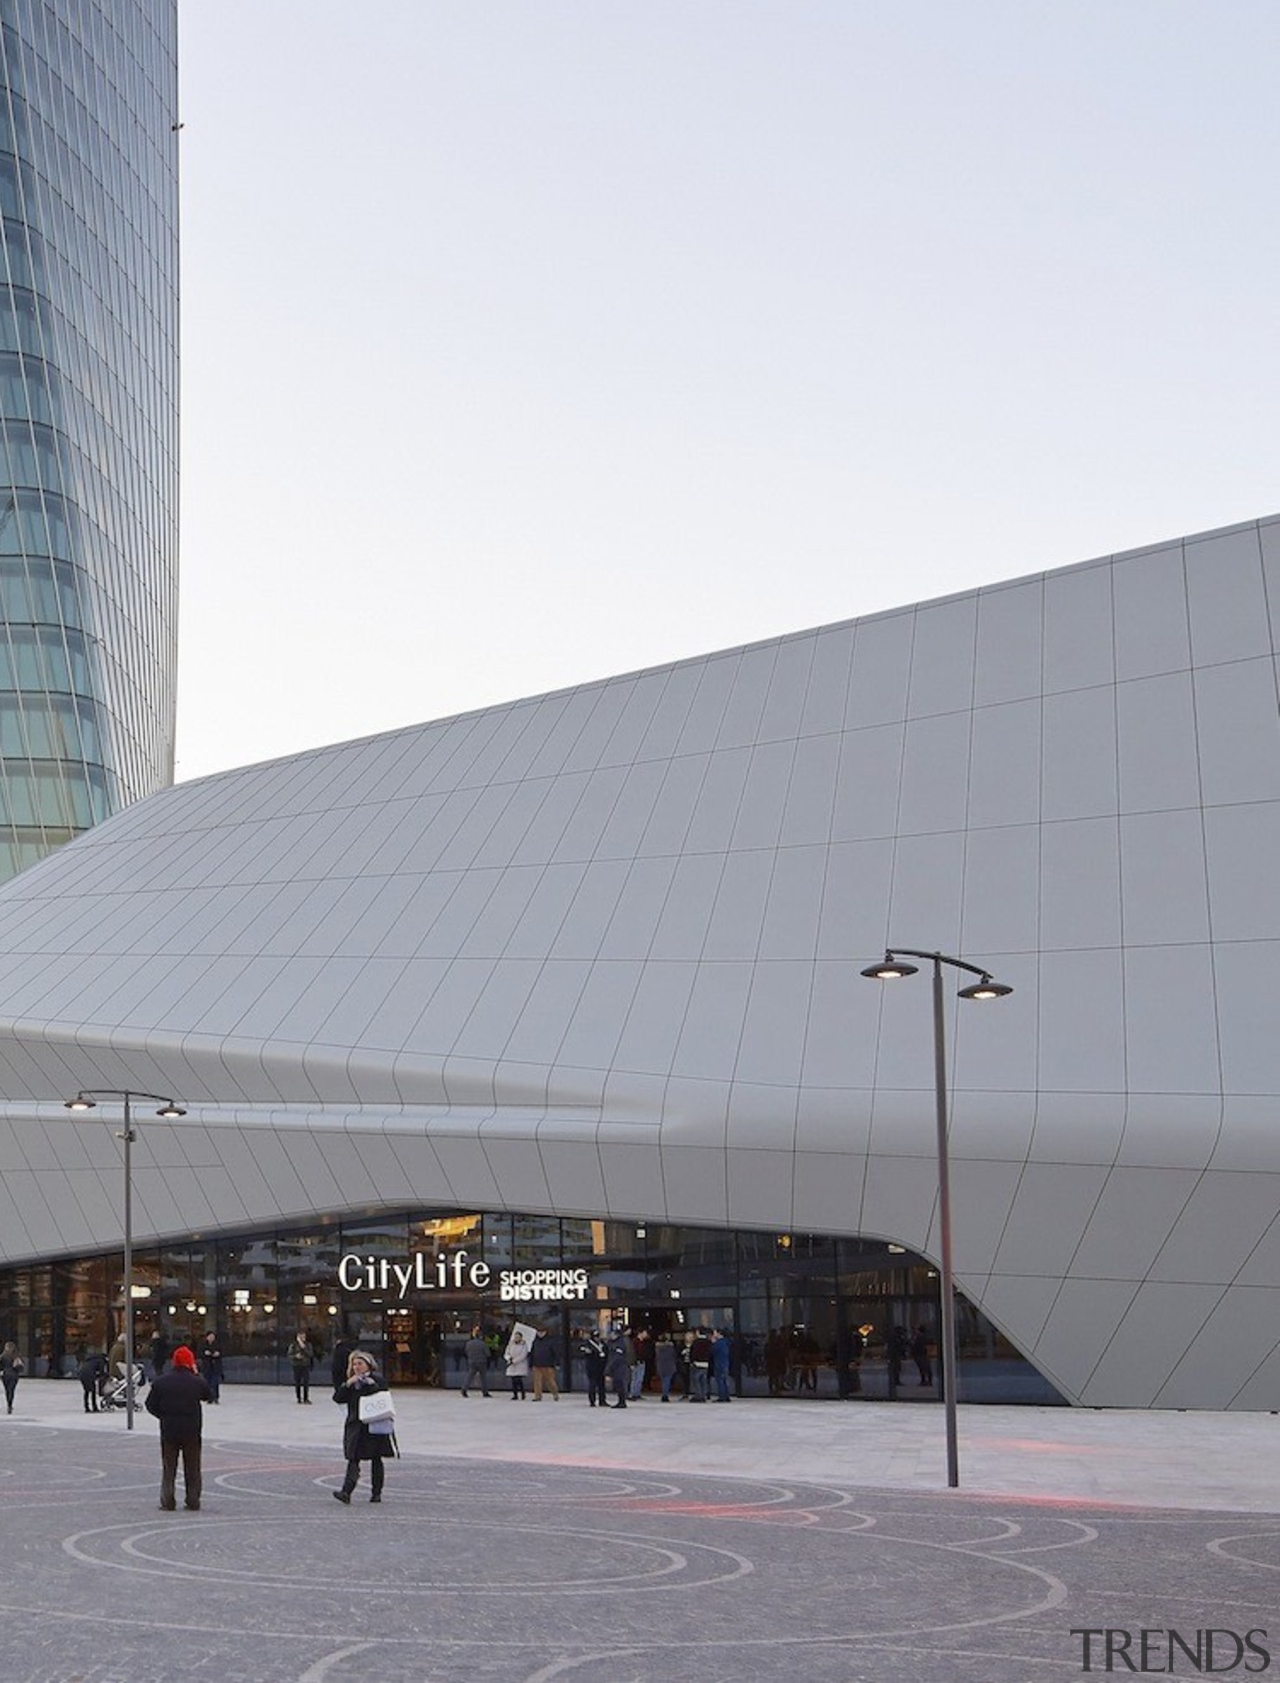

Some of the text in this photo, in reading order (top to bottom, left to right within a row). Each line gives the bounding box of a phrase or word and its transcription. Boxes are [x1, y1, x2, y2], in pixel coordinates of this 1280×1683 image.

[338, 1250, 490, 1299] CityLife
[500, 1269, 588, 1285] SHOPPING
[500, 1284, 588, 1301] DISTRICT
